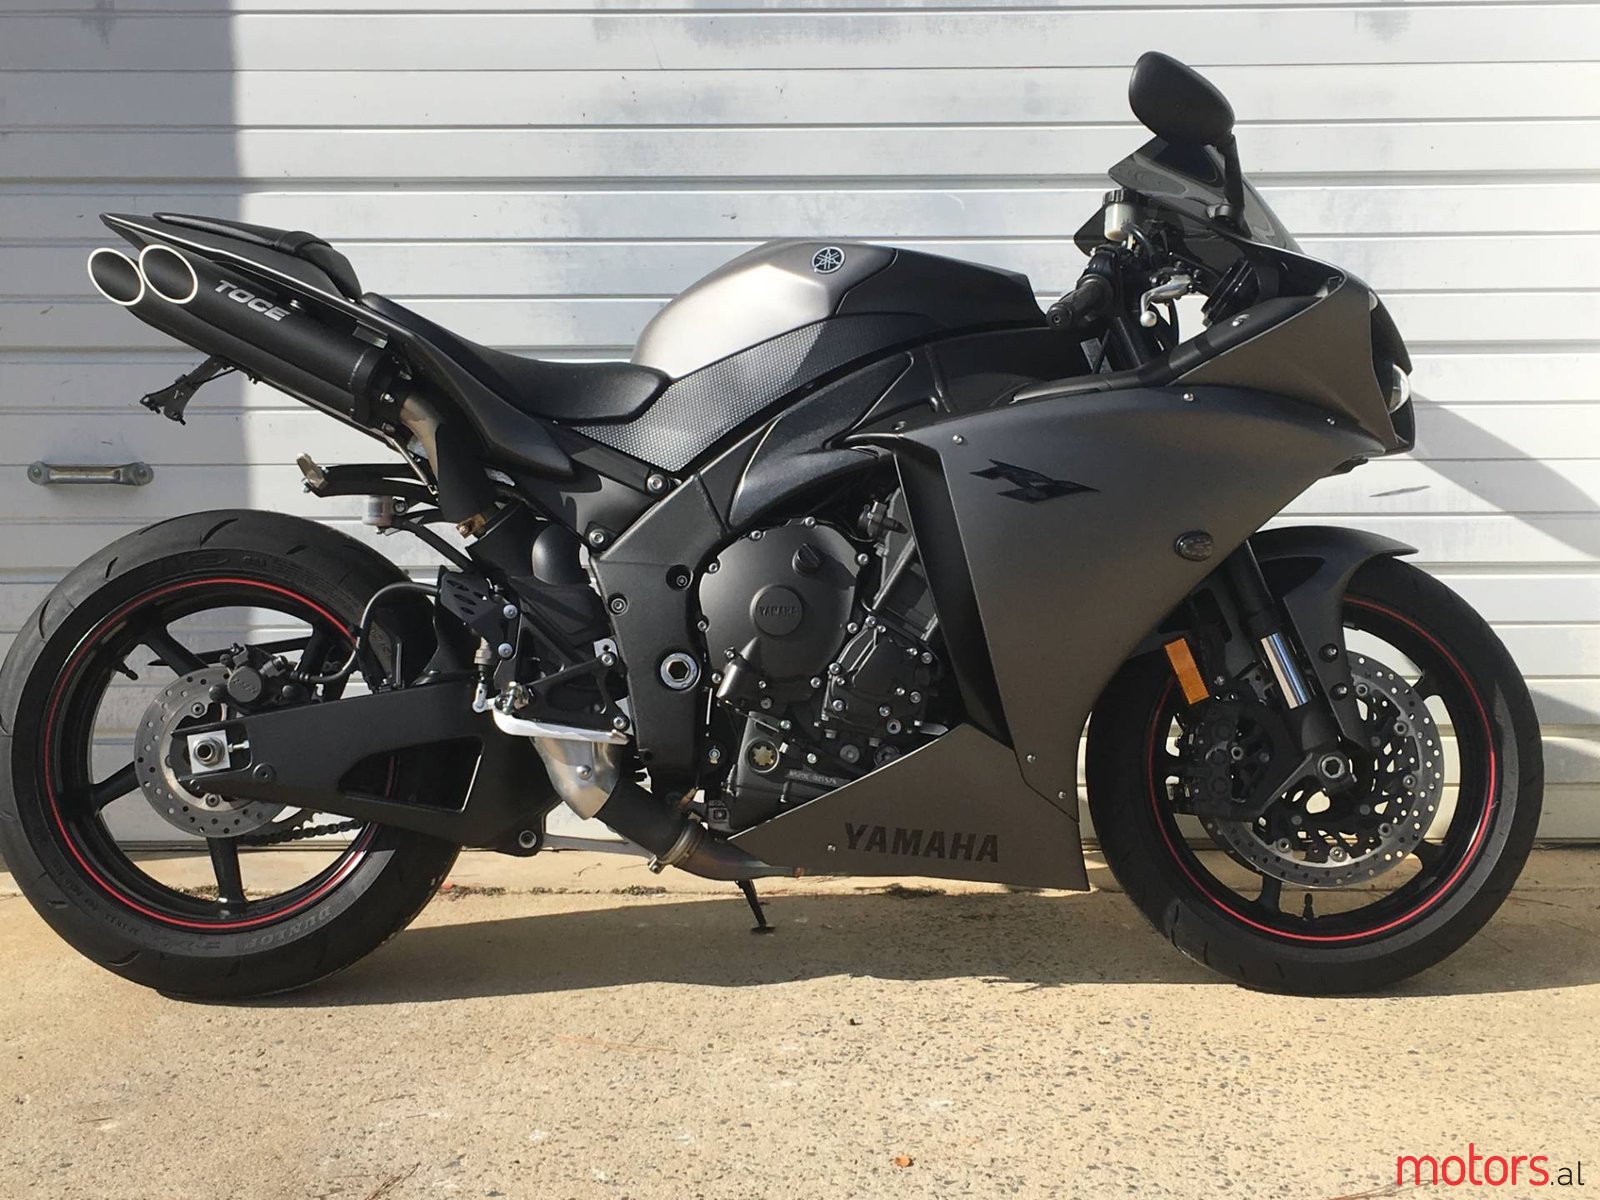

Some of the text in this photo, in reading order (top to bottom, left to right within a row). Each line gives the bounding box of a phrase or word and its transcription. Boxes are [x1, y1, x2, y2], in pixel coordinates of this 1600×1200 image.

[214, 279, 291, 322] TOCE
[759, 606, 799, 617] YAMAHA
[844, 822, 999, 863] YAMAHA
